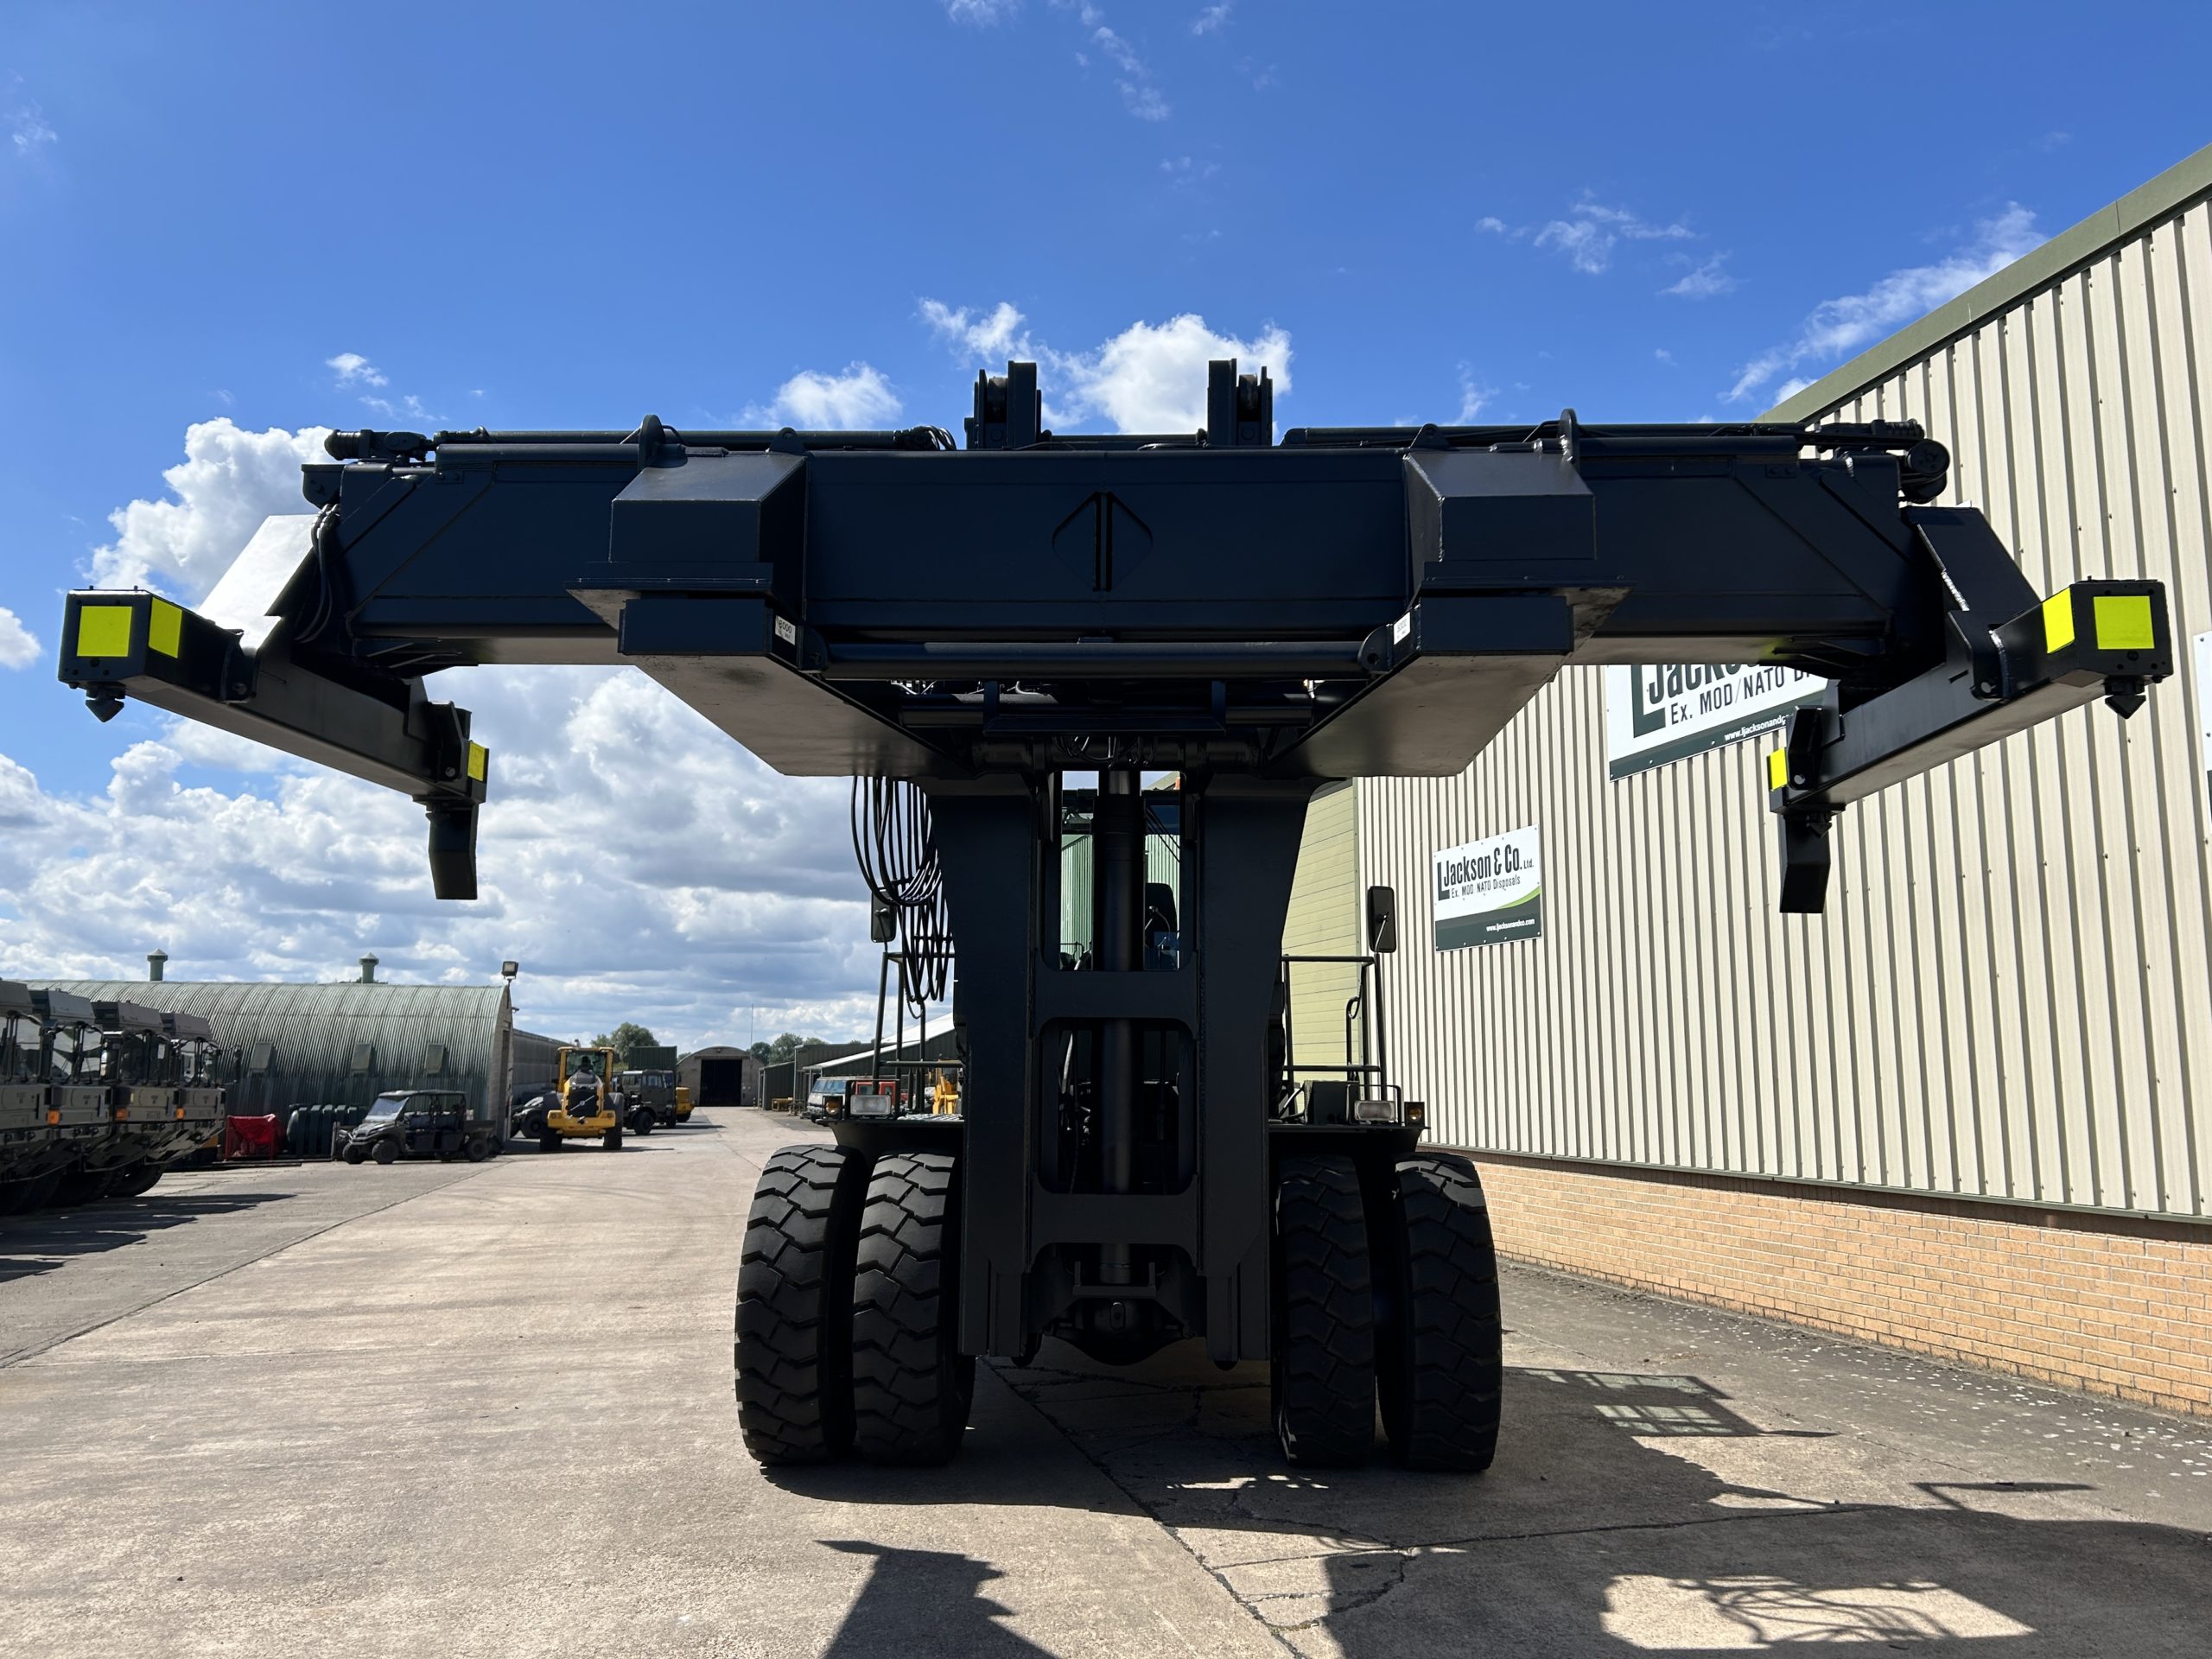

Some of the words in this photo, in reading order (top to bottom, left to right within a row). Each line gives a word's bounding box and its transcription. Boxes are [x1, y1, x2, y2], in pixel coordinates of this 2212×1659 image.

[1670, 702, 1693, 725] Ex.
[1493, 847, 1503, 876] &
[1504, 843, 1522, 874] Co.
[1451, 887, 1460, 899] Ex.
[1493, 874, 1521, 890] Disposals
